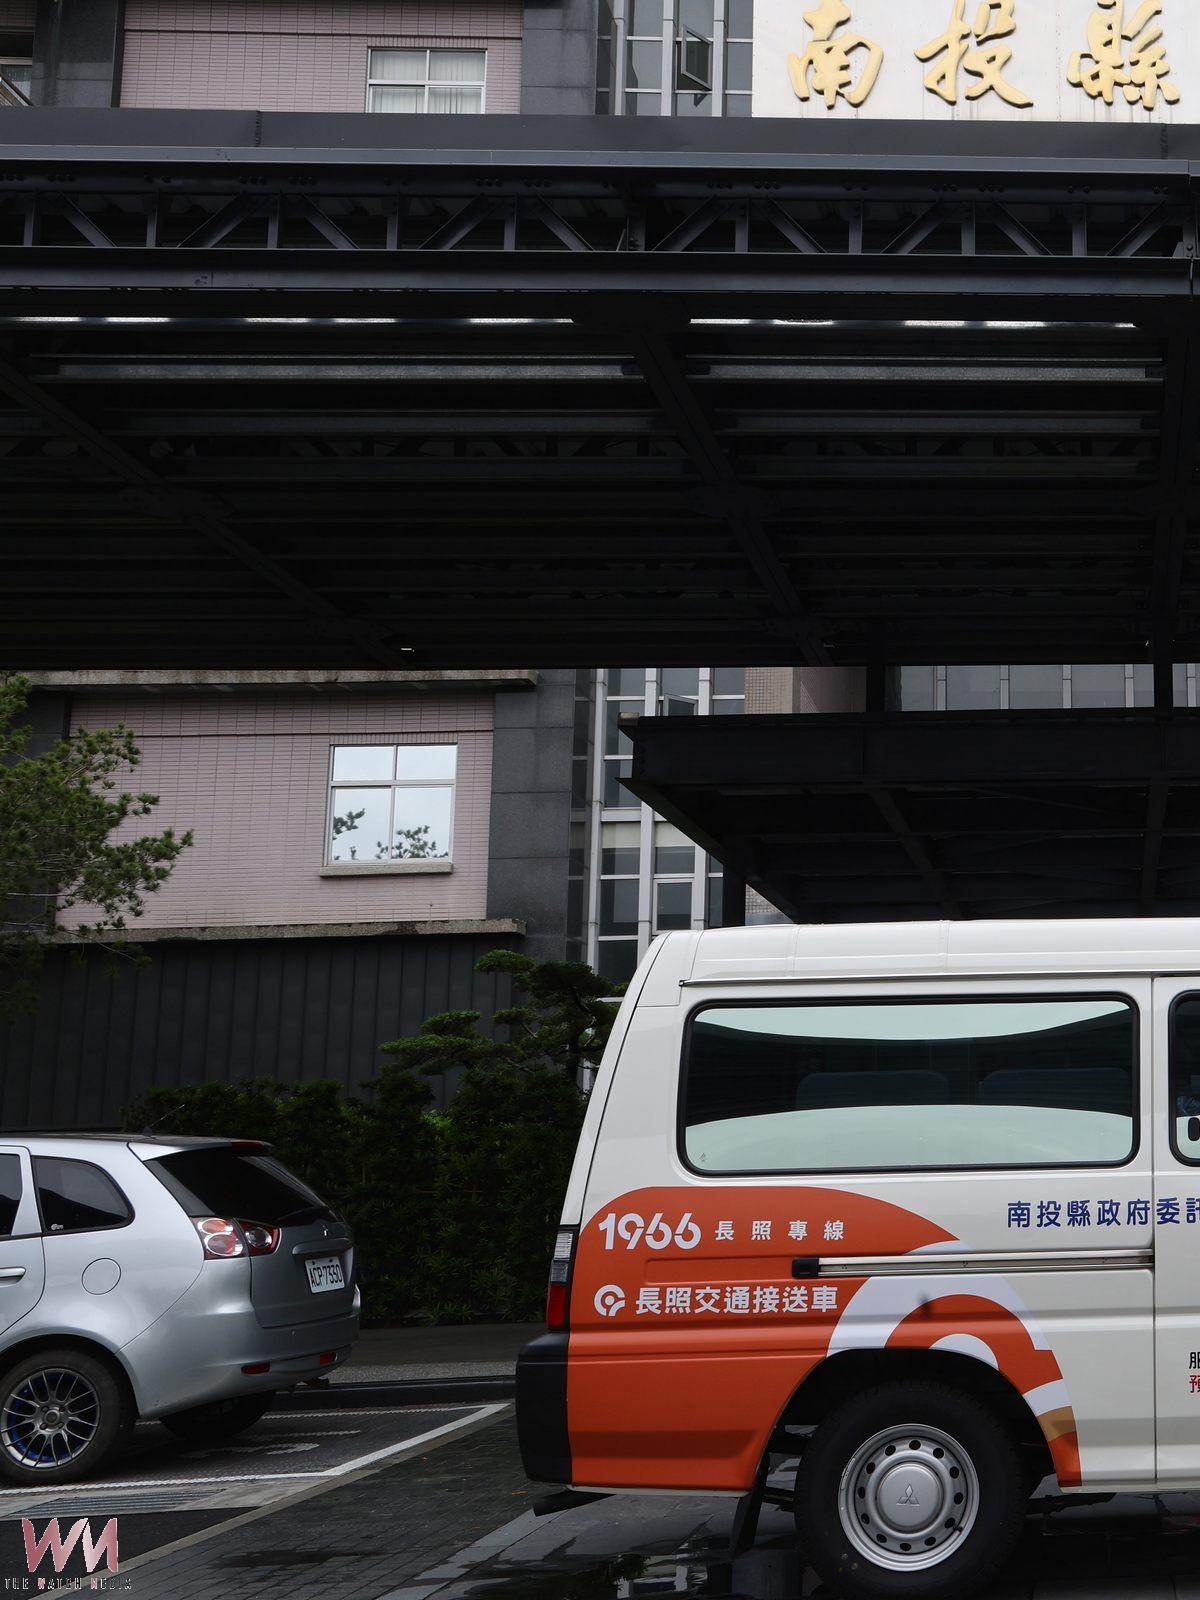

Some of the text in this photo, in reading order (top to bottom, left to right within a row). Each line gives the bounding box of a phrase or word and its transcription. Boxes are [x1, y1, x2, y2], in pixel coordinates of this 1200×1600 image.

[598, 1212, 844, 1251] 1966 長照專線
[635, 1285, 838, 1315] 長照交通接送車
